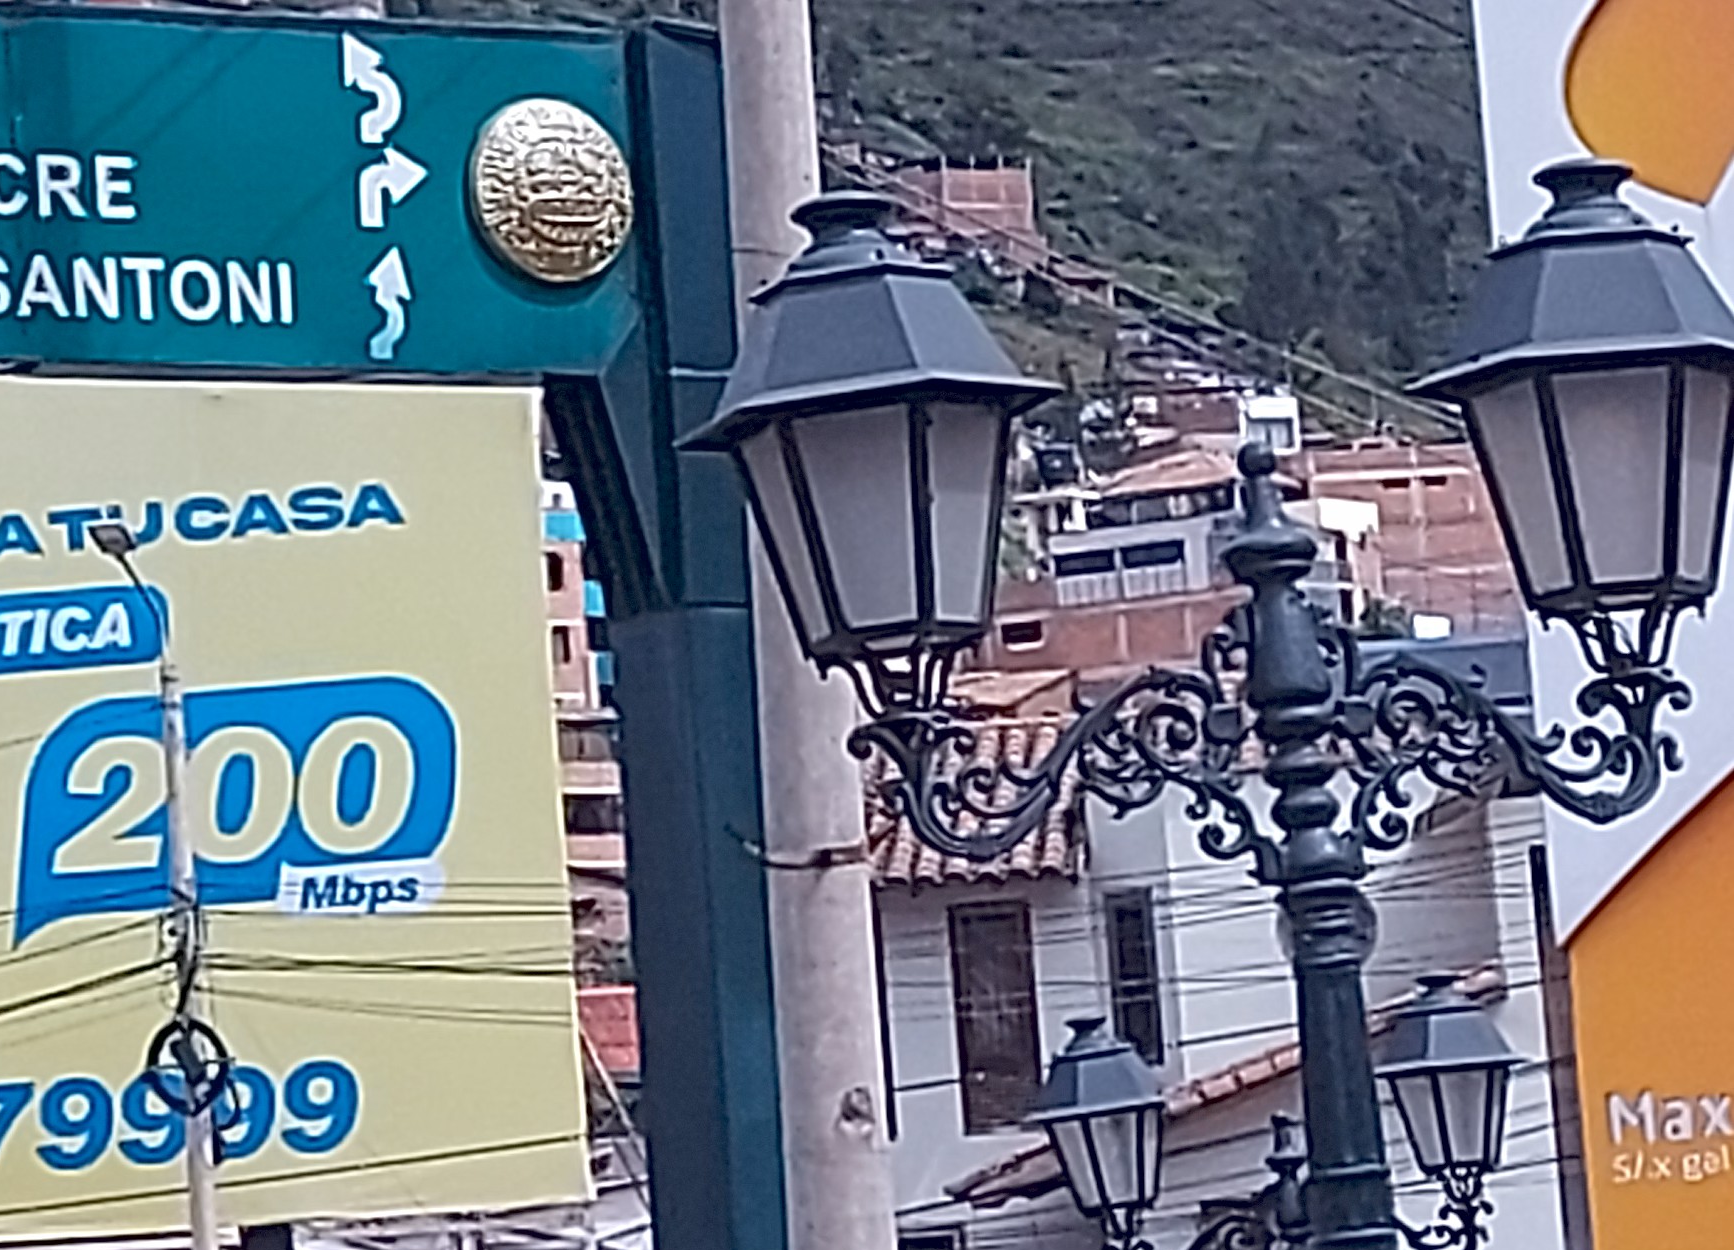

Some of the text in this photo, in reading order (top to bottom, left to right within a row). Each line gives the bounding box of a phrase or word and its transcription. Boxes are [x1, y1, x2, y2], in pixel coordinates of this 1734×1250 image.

[175, 483, 405, 545] CASA
[52, 715, 415, 876] 200
[299, 873, 420, 914] Mbps
[1609, 1090, 1734, 1144] Max
